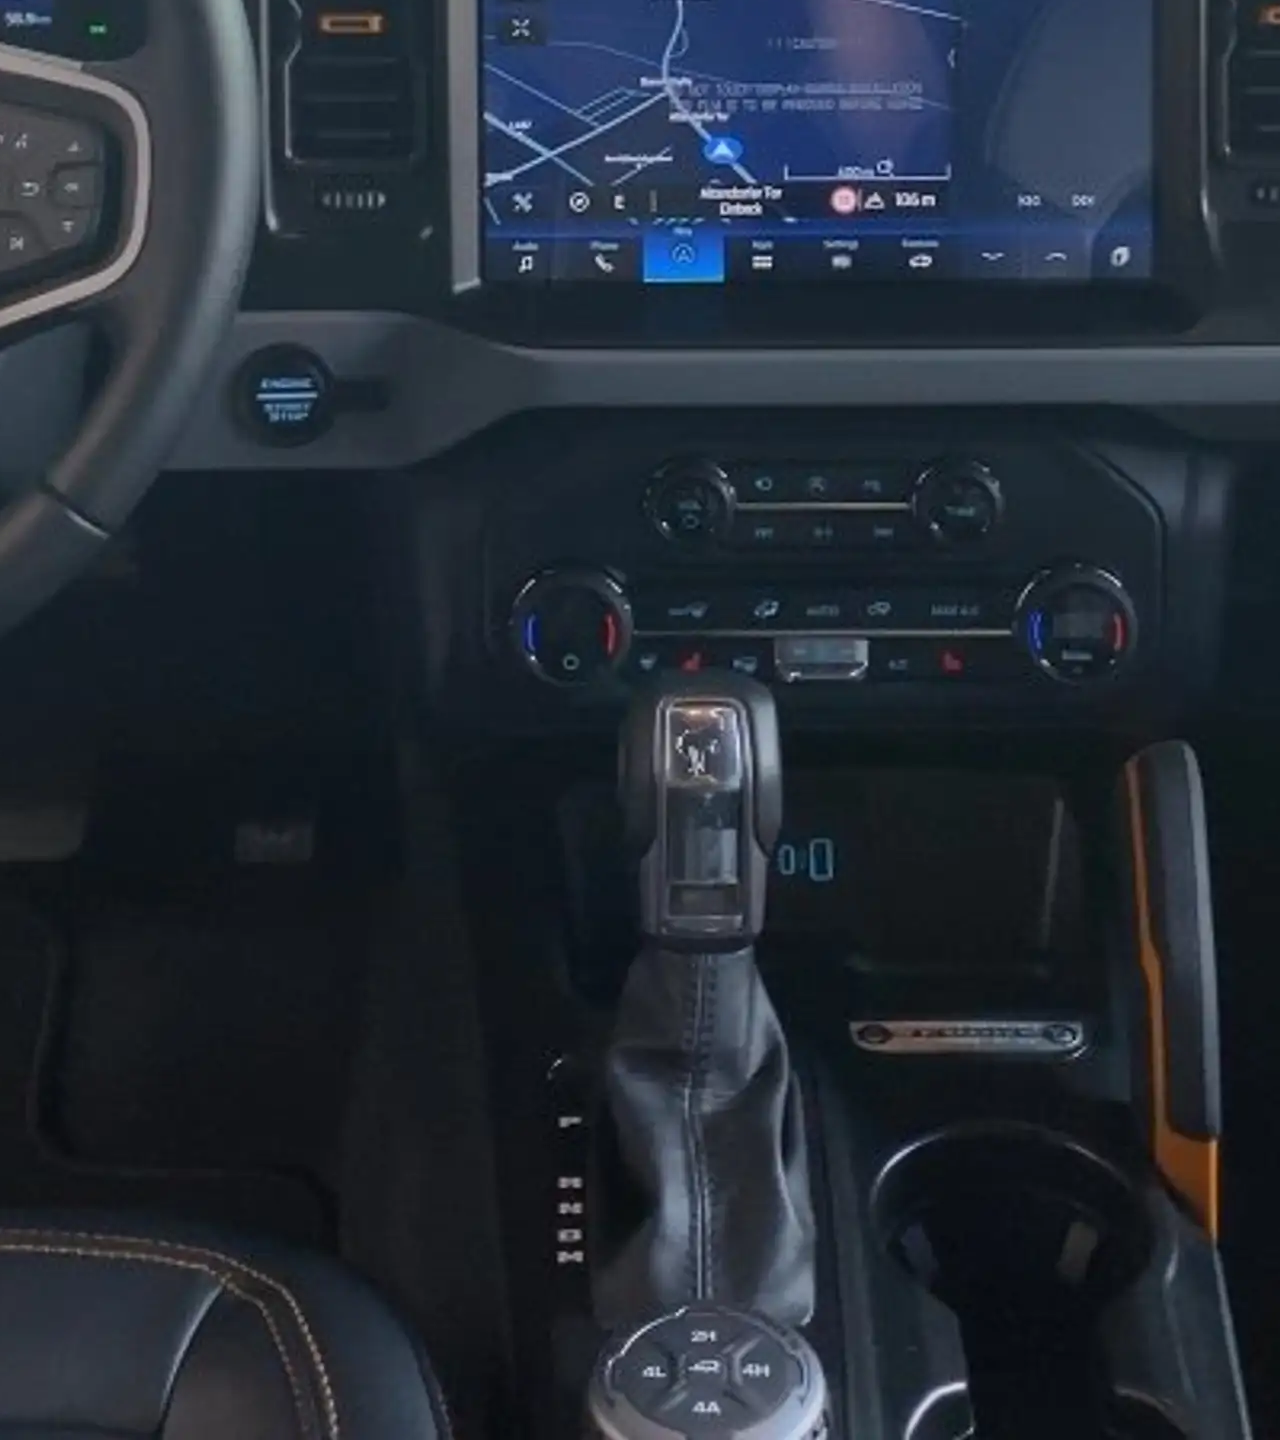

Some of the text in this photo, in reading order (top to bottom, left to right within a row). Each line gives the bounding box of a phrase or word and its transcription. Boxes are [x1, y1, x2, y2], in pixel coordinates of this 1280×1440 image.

[642, 1365, 666, 1378] 4L
[742, 1363, 770, 1377] 4H
[692, 1401, 720, 1414] 4A
